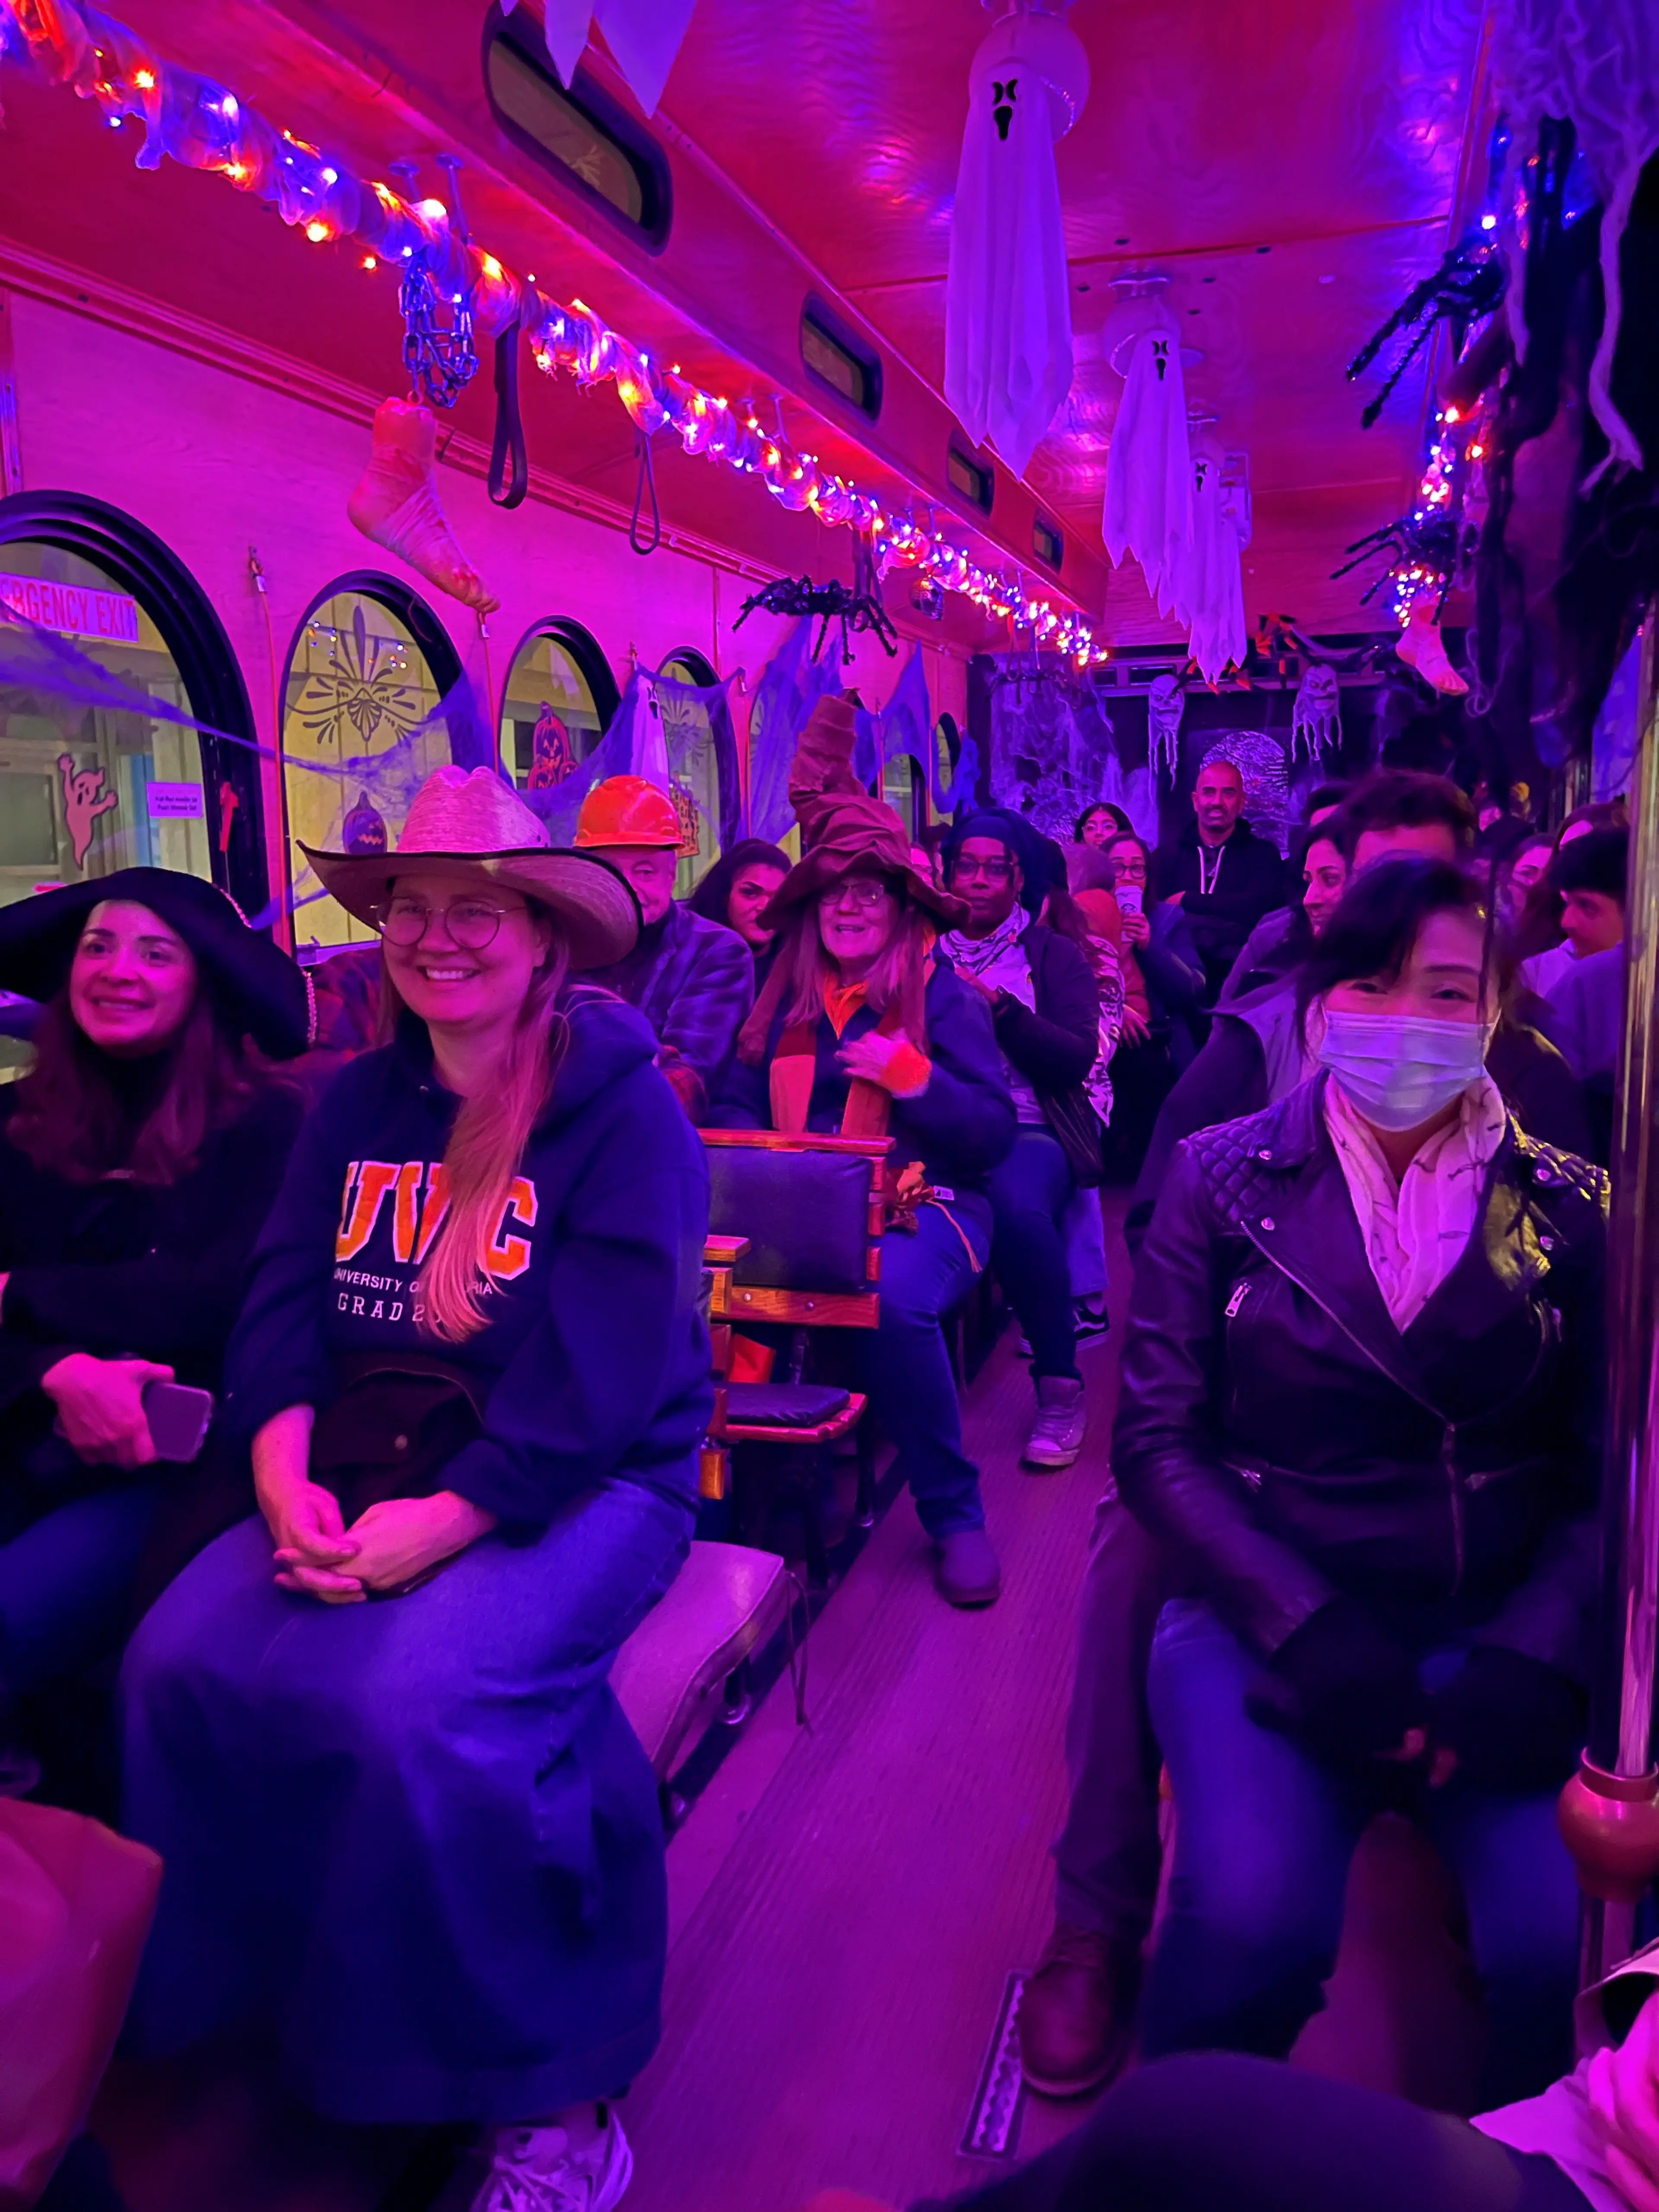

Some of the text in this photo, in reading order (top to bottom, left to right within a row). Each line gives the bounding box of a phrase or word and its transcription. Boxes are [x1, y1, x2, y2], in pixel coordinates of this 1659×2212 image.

[95, 595, 133, 637] EXIT
[335, 1161, 538, 1281] UVC
[337, 1293, 403, 1321] GRAD
